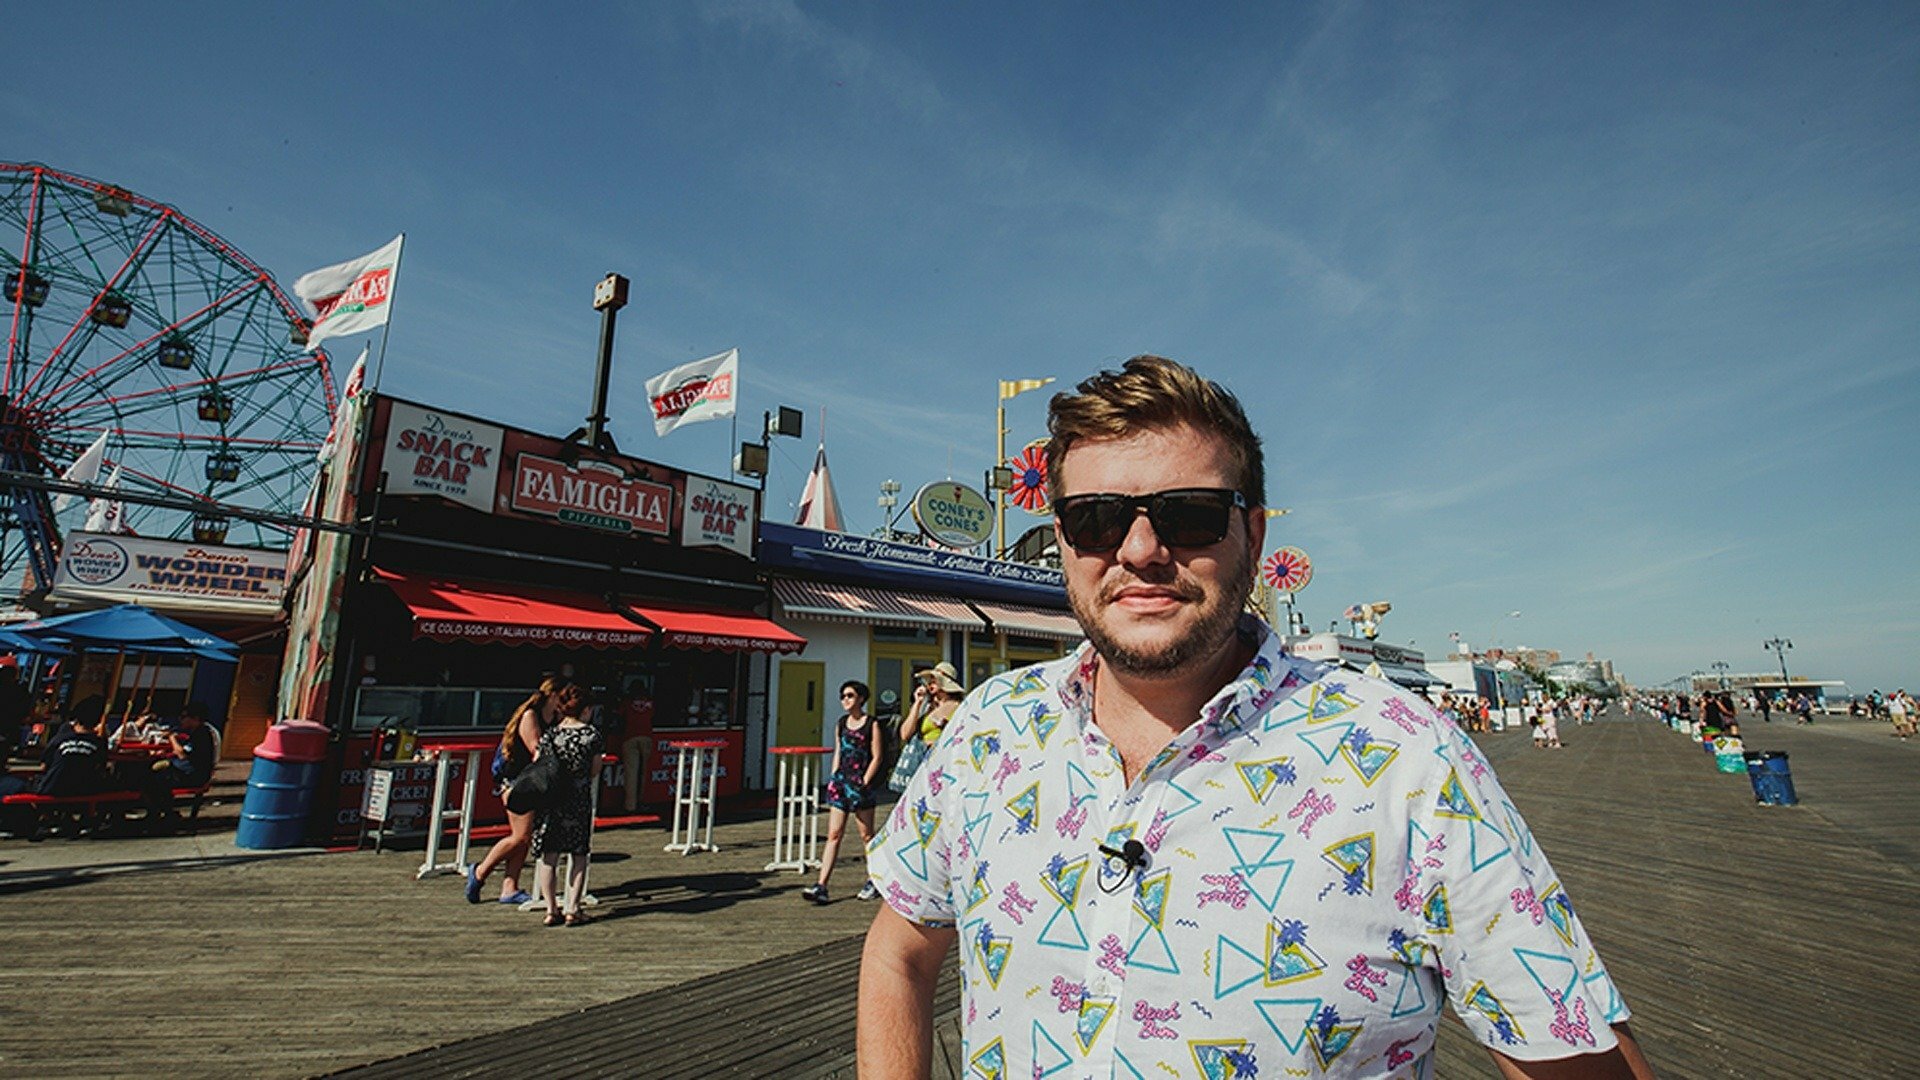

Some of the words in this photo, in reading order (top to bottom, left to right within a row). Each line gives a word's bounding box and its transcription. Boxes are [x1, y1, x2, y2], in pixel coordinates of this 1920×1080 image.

[396, 429, 492, 467] SNACK
[414, 455, 471, 485] BAR
[413, 479, 442, 491] SINCE
[520, 467, 664, 523] FAMIGLIA
[690, 494, 748, 521] SNACK
[928, 499, 985, 522] CONEY'S
[567, 510, 625, 531] PIZZERIA
[702, 514, 737, 535] BAR
[934, 513, 980, 533] CONES
[70, 542, 119, 559] Deno's
[824, 536, 867, 553] Fresh
[183, 548, 249, 563] Deno's
[136, 554, 286, 579] WONDER
[150, 571, 269, 593] WHEEL
[421, 622, 436, 634] ICE
[437, 623, 463, 635] COLD
[464, 624, 489, 636] SODA
[494, 626, 527, 637] ITALIAN
